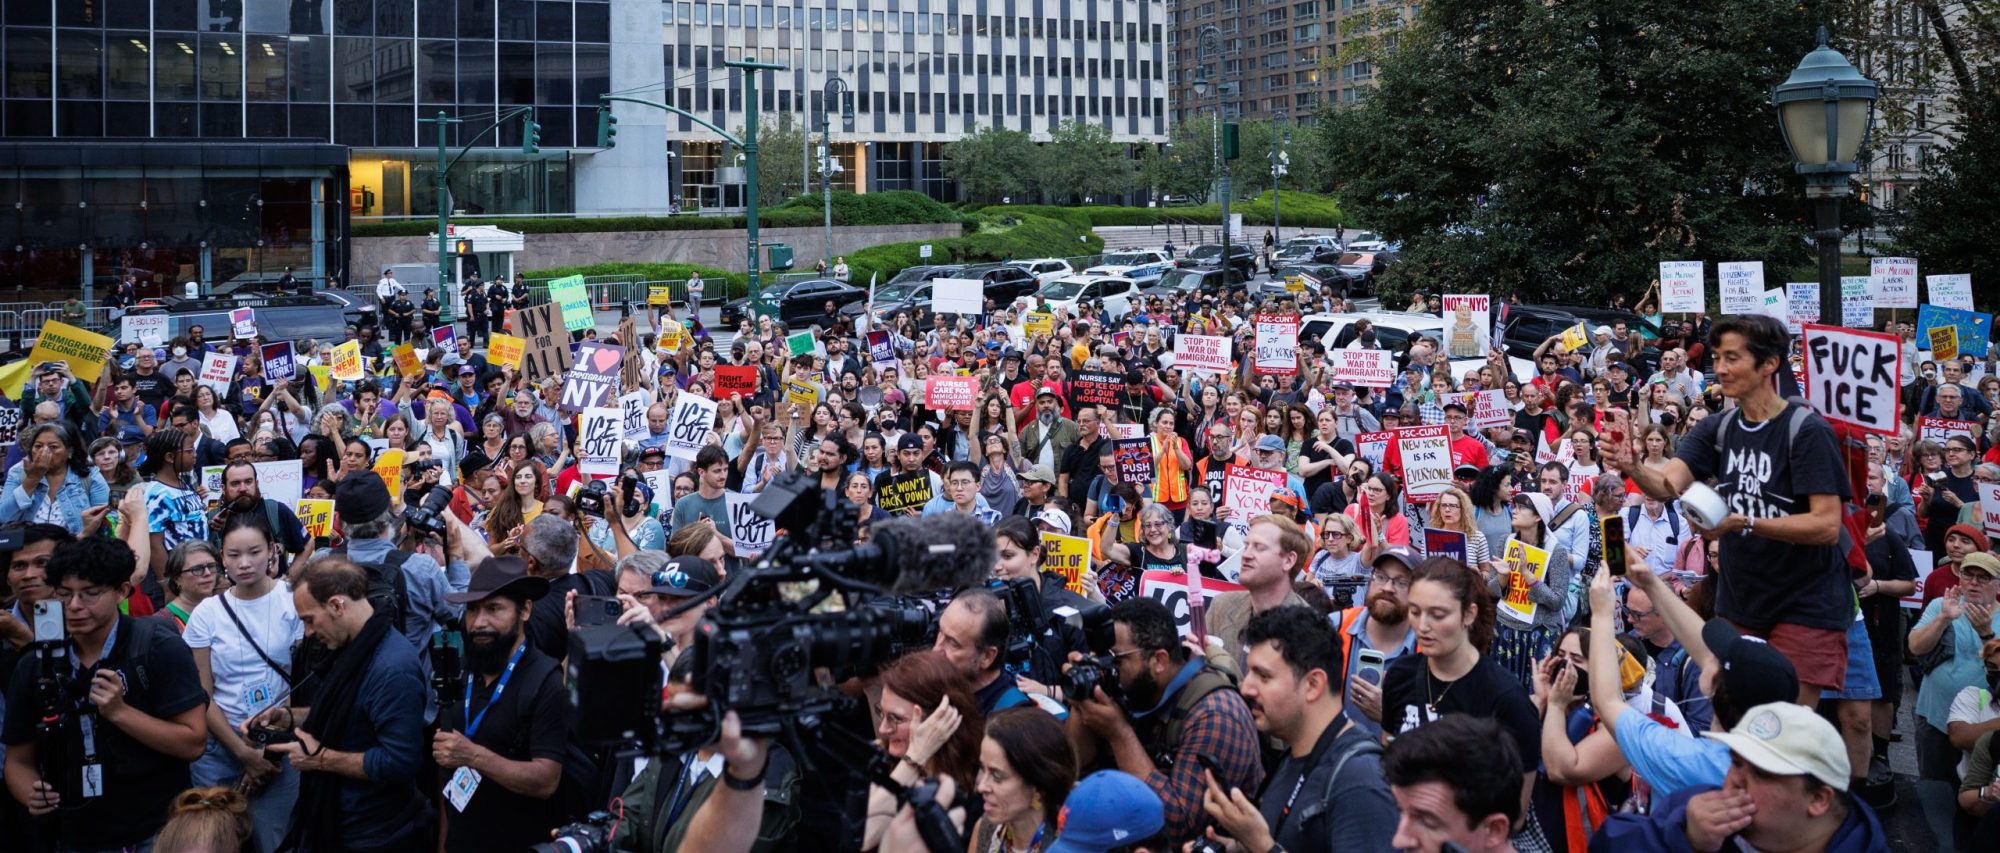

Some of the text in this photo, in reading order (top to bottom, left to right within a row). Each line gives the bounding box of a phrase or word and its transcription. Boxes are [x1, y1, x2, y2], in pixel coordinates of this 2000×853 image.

[1720, 271, 1755, 280] CITIZENSHIP
[1888, 267, 1913, 275] MILITANT
[1672, 288, 1695, 296] ACTION!
[1444, 297, 1463, 312] NOT
[1469, 298, 1488, 312] NYC
[129, 317, 163, 326] ABOLISH
[520, 305, 552, 337] NY
[134, 328, 158, 338] ICE
[1259, 324, 1296, 333] ICE OUT
[43, 332, 106, 356] IMMIGRANTS
[437, 337, 453, 348] NEW
[535, 335, 552, 349] FOR
[1184, 337, 1221, 347] STOP THE
[1932, 336, 1952, 344] PROUD
[40, 340, 102, 364] BELONG HERE
[347, 349, 354, 358] OF
[871, 342, 888, 354] NEW
[1188, 346, 1217, 355] WAR ON
[1257, 347, 1295, 359] NEW YORK
[1934, 343, 1947, 352] CITY
[574, 346, 596, 371] I
[873, 350, 892, 361] YORK!
[1176, 353, 1228, 366] IMMIGRANTS!
[1343, 352, 1362, 360] STOP
[1809, 335, 1896, 388] FUCK
[213, 359, 227, 368] ICE
[266, 355, 287, 371] NEW
[335, 358, 355, 372] NEW
[527, 346, 570, 381] ALL
[1346, 360, 1378, 369] WAR ON
[267, 363, 294, 379] YORK!
[336, 364, 360, 377] YORK!
[568, 370, 614, 383] IMMIGRANT
[1335, 367, 1389, 378] IMMIGRANTS!
[1079, 374, 1107, 382] NURSES
[718, 381, 753, 389] FASCISM
[1074, 381, 1095, 389] KEEP
[562, 378, 609, 408] NY
[1077, 396, 1120, 405] HOSPITALS
[1824, 380, 1878, 424] ICE
[623, 399, 641, 419] ICE
[677, 402, 712, 426] ICE
[586, 416, 622, 439] ICE
[1925, 419, 1972, 429] PSC-CUNY
[674, 422, 711, 444] OUT
[1399, 427, 1443, 438] PSC-CUNY
[1924, 428, 1951, 439] ICE
[585, 438, 618, 457] OUT
[1401, 439, 1446, 451] NEW YORK
[1414, 452, 1436, 461] IS FOR
[381, 466, 388, 476] UP
[388, 465, 399, 476] FOR
[1122, 463, 1150, 473] PUSH
[1726, 446, 1772, 483] MAD
[1124, 473, 1150, 482] BACK
[1405, 468, 1451, 485] EVERYONE
[1571, 474, 1590, 484] THE
[881, 477, 926, 496] WE WON'T
[1229, 477, 1267, 494] NEW
[1738, 474, 1761, 496] FOR
[880, 488, 931, 508] BACK DOWN
[1235, 493, 1271, 512] YORK
[299, 503, 312, 515] ICE
[298, 512, 327, 527] OUT OF
[308, 523, 324, 537] EW
[735, 522, 771, 543] OUT
[1046, 540, 1061, 552] ICE
[1046, 554, 1082, 567] OUT OF
[1527, 562, 1540, 575] OF
[1114, 576, 1135, 601] PUSH
[1287, 773, 1305, 807] SONY
